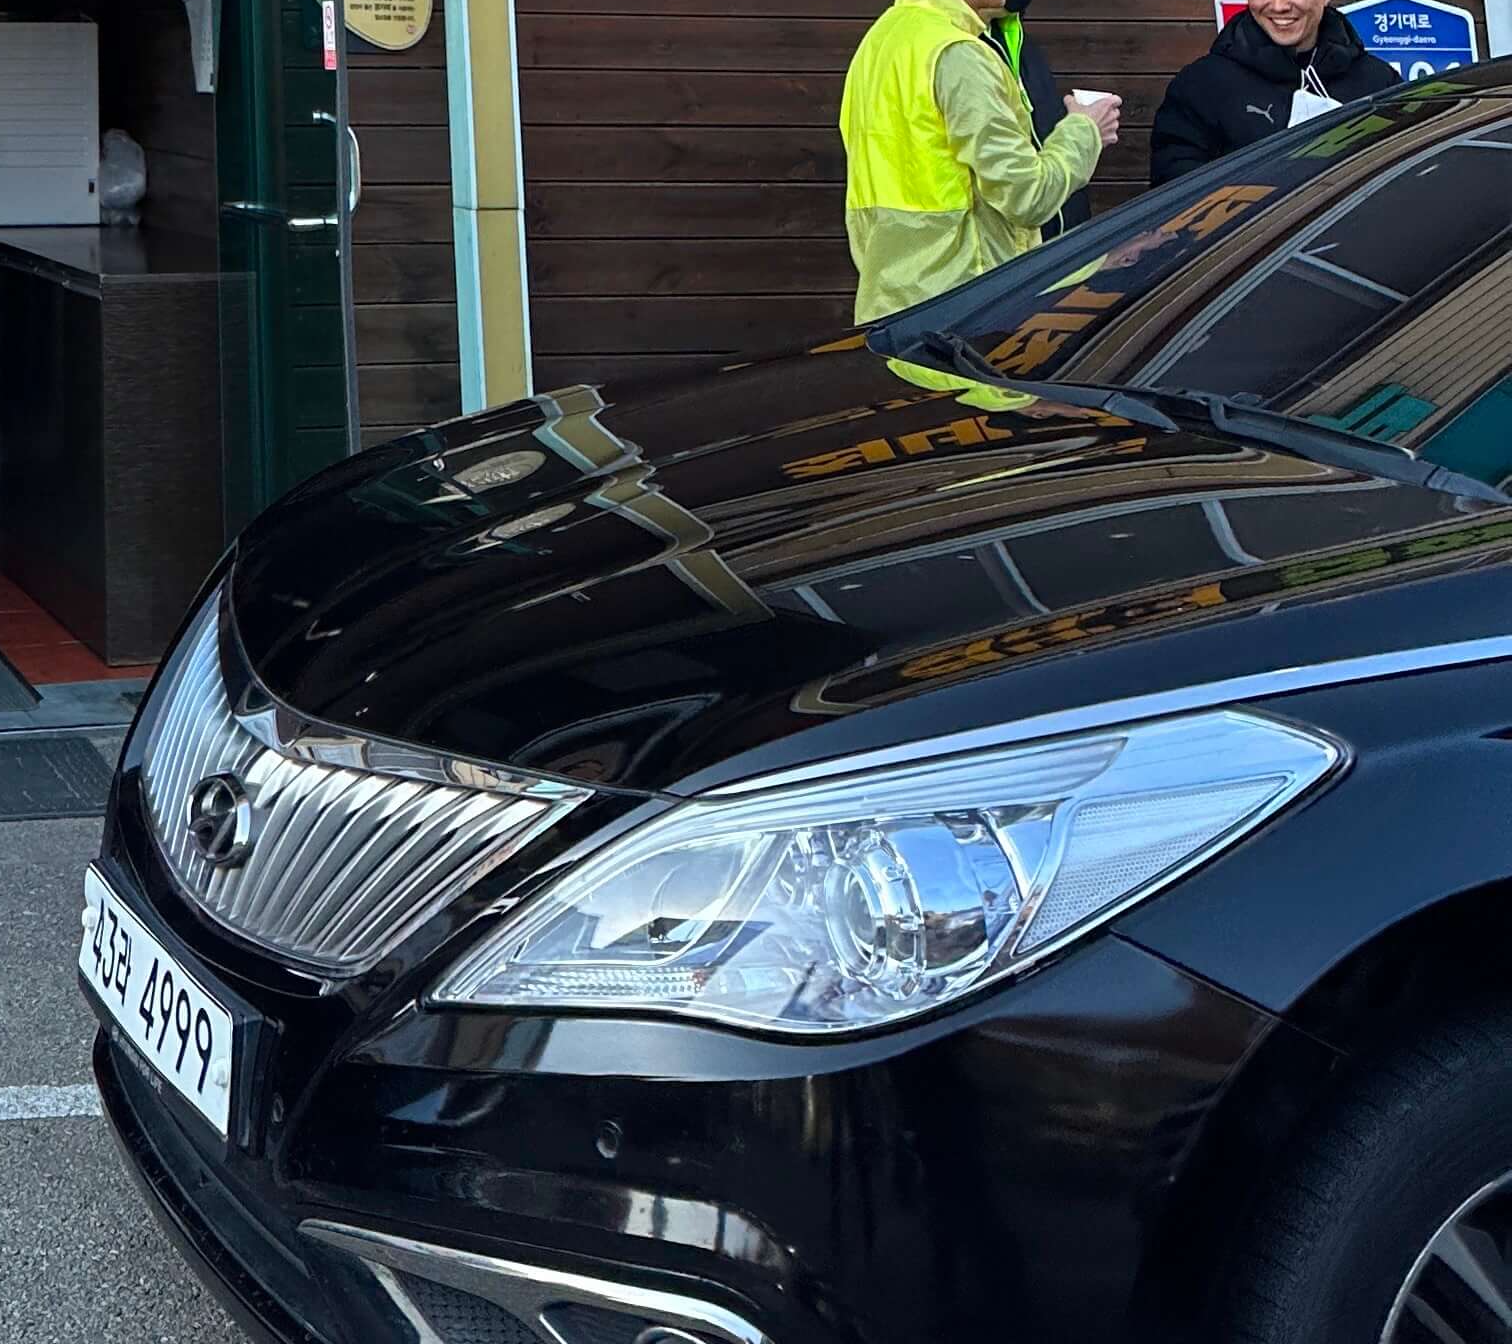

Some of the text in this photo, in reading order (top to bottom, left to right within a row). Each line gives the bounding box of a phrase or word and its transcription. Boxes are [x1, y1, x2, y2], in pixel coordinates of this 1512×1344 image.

[1374, 13, 1433, 32] 경기대로
[92, 896, 213, 1094] 43라 4999
